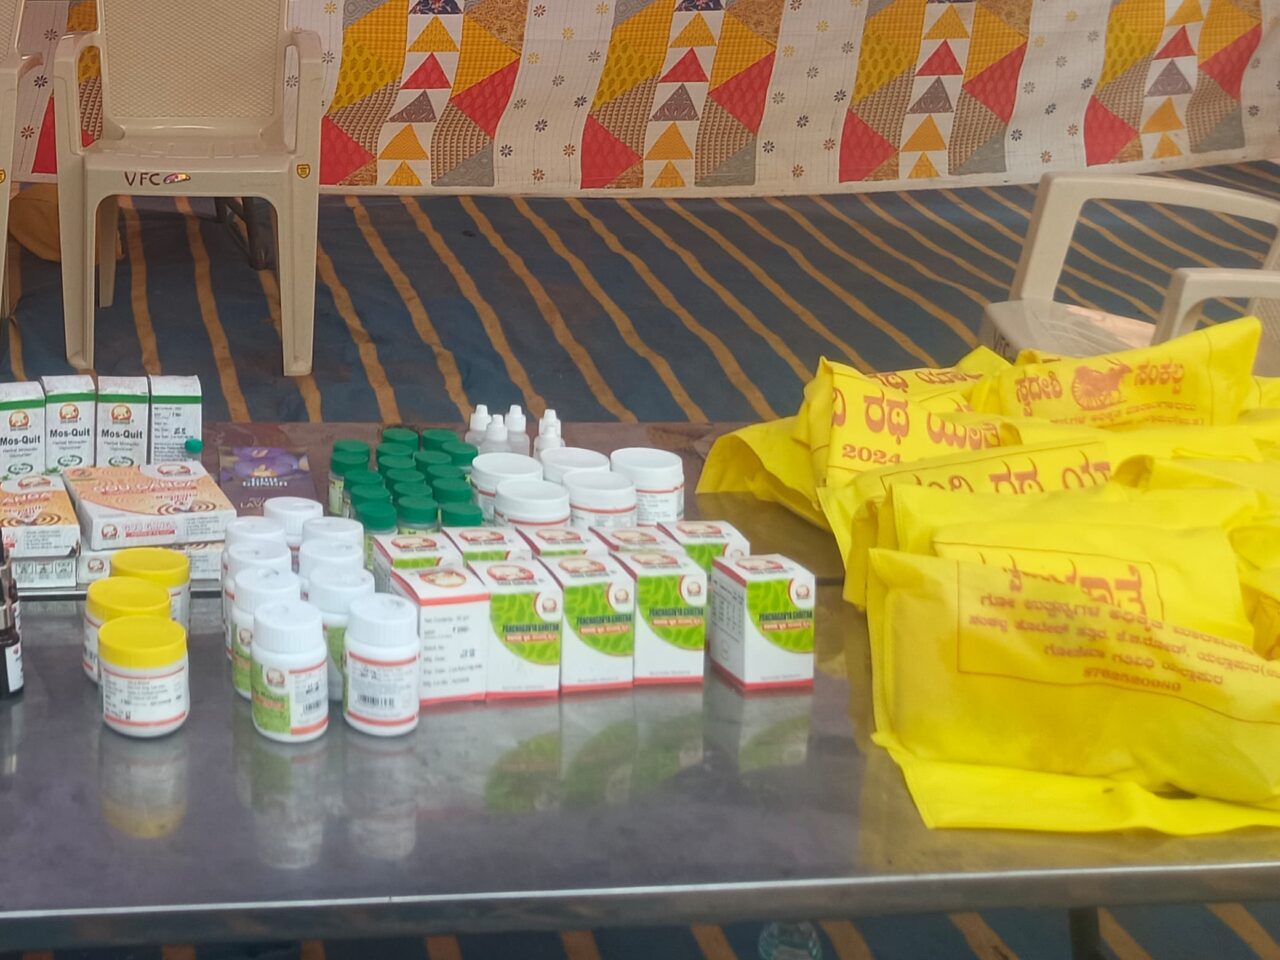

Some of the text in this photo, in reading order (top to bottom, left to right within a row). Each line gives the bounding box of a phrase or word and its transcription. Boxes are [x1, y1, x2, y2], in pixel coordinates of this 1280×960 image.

[124, 172, 160, 186] VFC
[49, 428, 91, 439] Mos-Quit
[101, 429, 143, 440] Mos-Quit
[0, 435, 41, 446] Mos-Quit
